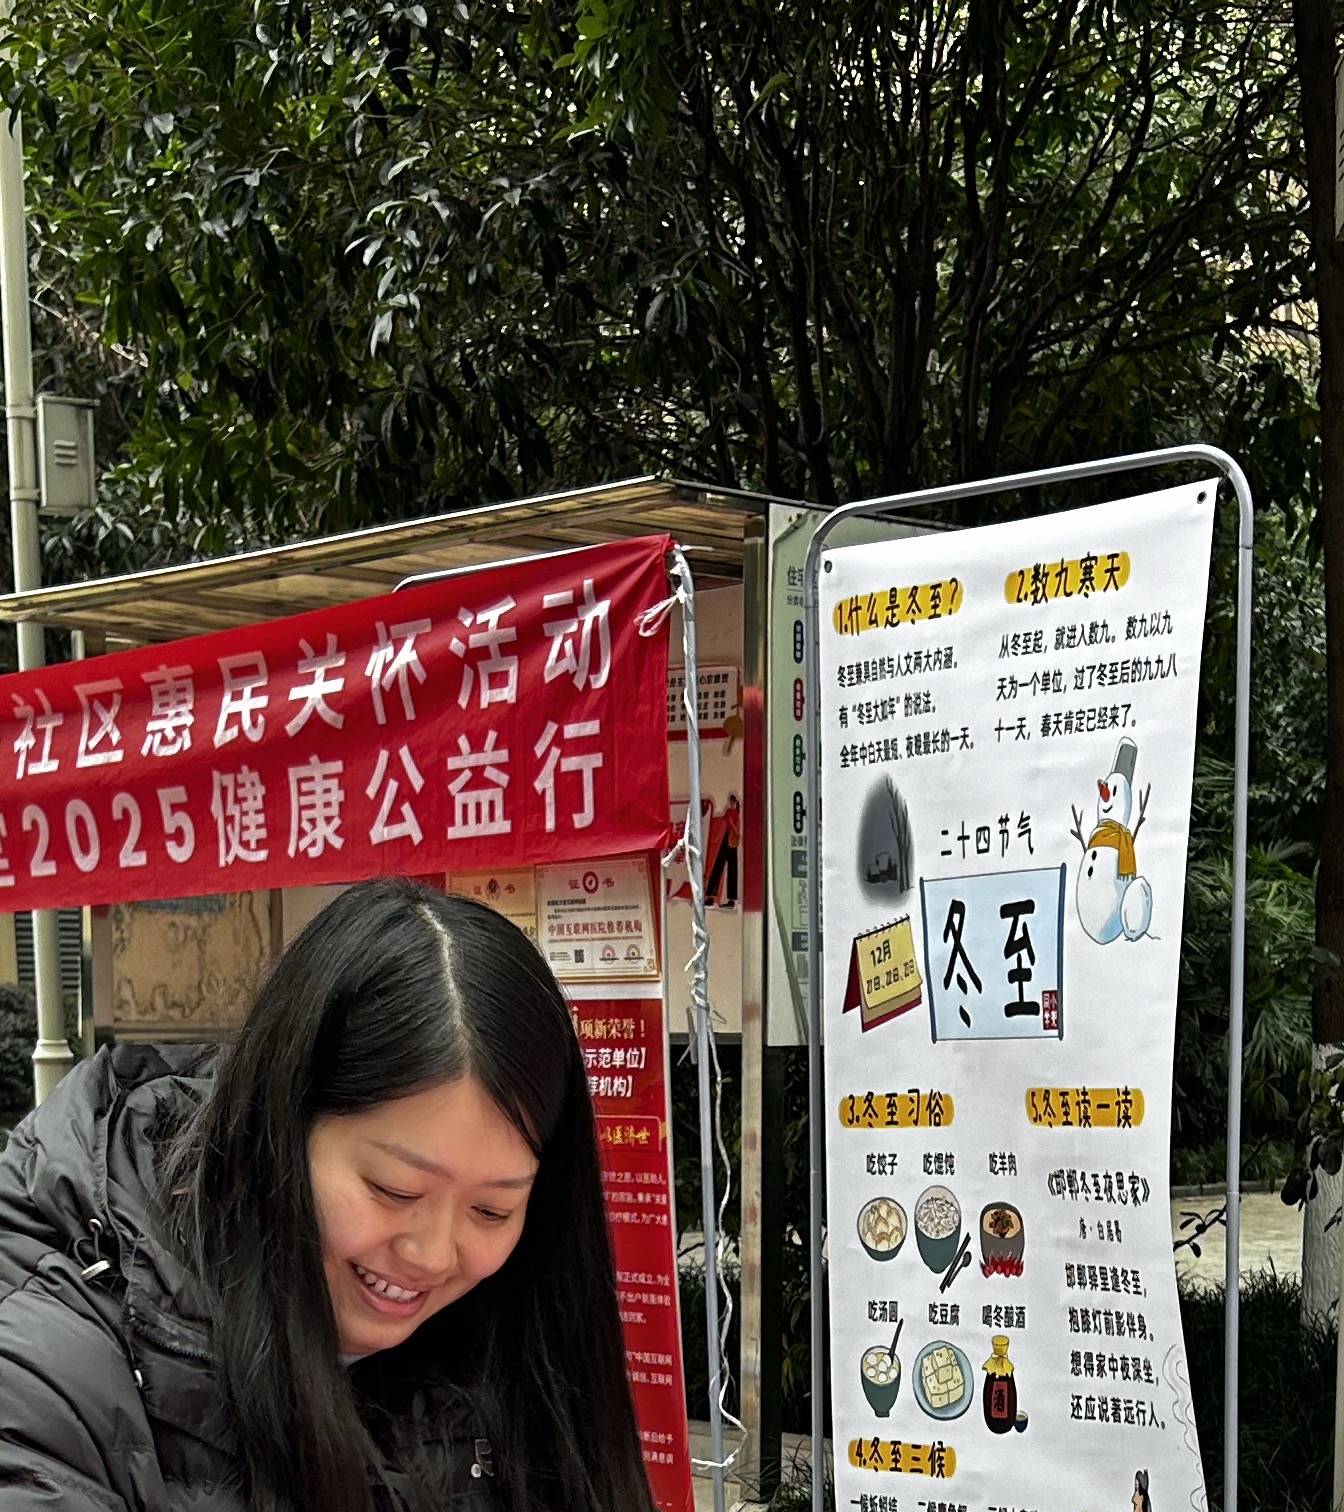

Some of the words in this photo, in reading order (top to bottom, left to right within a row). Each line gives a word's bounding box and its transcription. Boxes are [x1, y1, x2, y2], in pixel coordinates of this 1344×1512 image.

[1015, 551, 1120, 606] 2.数九寒天
[940, 810, 1034, 859] 二十四节气
[870, 938, 892, 968] 12月
[942, 898, 1041, 1030] 冬至
[847, 1088, 945, 1128] 3.冬至习俗
[1031, 1085, 1133, 1129] 5.冬至读一读
[866, 1152, 898, 1176] 吃饺子
[923, 1152, 956, 1176] 吃馄饨
[988, 1151, 1018, 1176] 吃羊肉
[868, 1300, 899, 1323] 吃汤圆
[928, 1302, 960, 1326] 吃豆腐
[855, 1436, 947, 1479] 4.冬至三候
